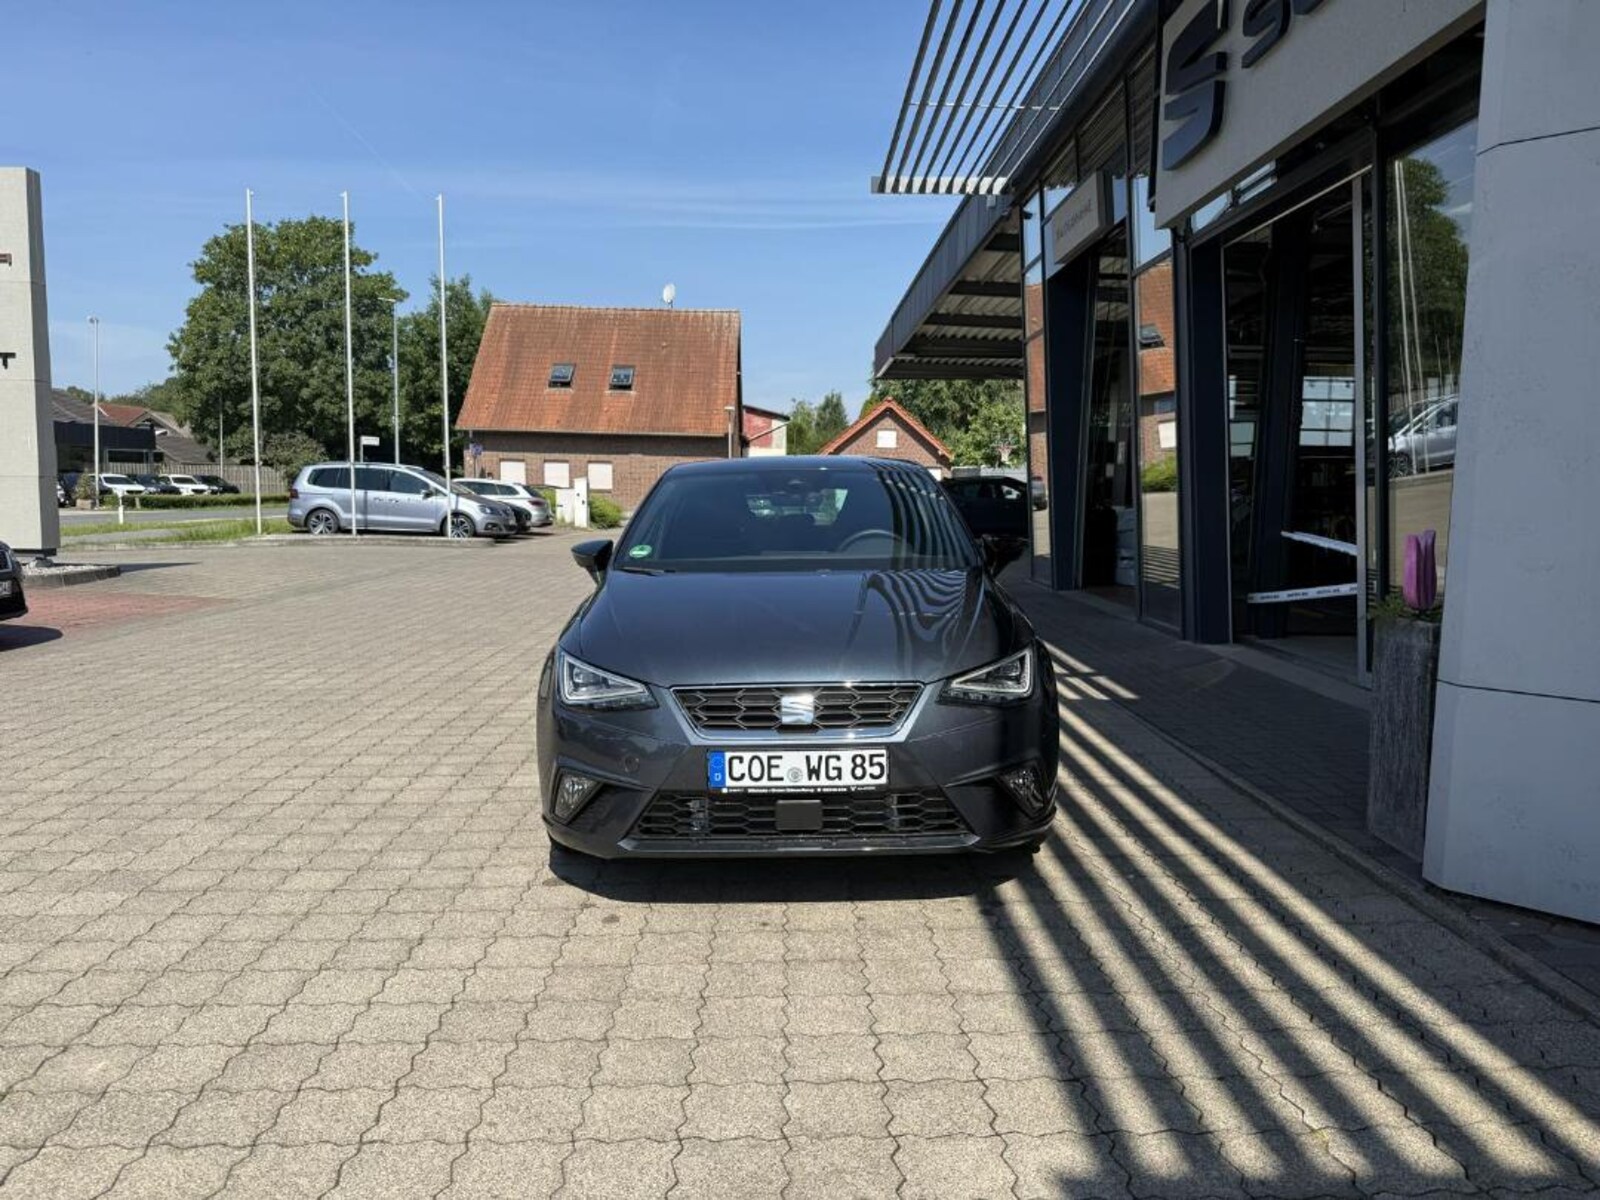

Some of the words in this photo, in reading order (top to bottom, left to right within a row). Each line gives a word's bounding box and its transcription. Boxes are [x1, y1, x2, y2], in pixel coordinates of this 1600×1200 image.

[728, 755, 784, 782] COE
[805, 755, 843, 782] WG
[850, 754, 886, 781] 85
